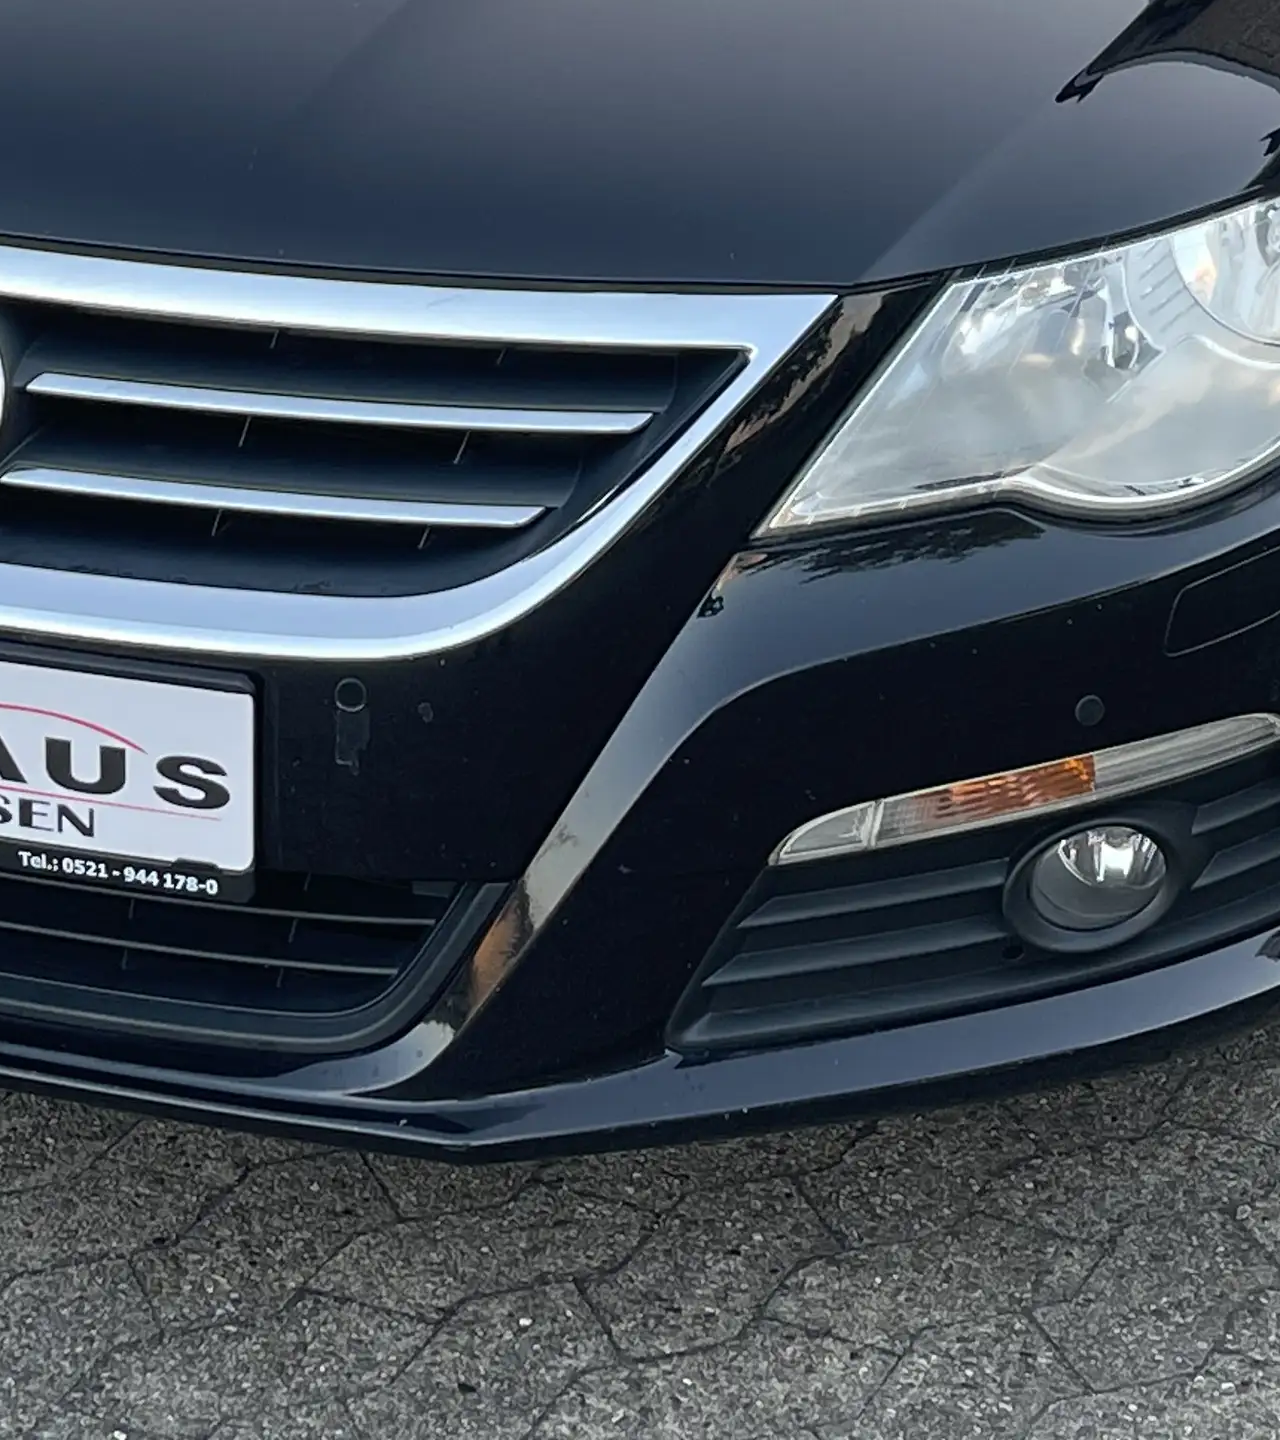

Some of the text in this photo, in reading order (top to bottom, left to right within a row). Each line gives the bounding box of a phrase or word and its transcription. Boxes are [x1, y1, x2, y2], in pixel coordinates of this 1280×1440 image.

[61, 857, 108, 879] 0521
[123, 865, 159, 888] 944
[163, 873, 219, 896] 178-0
